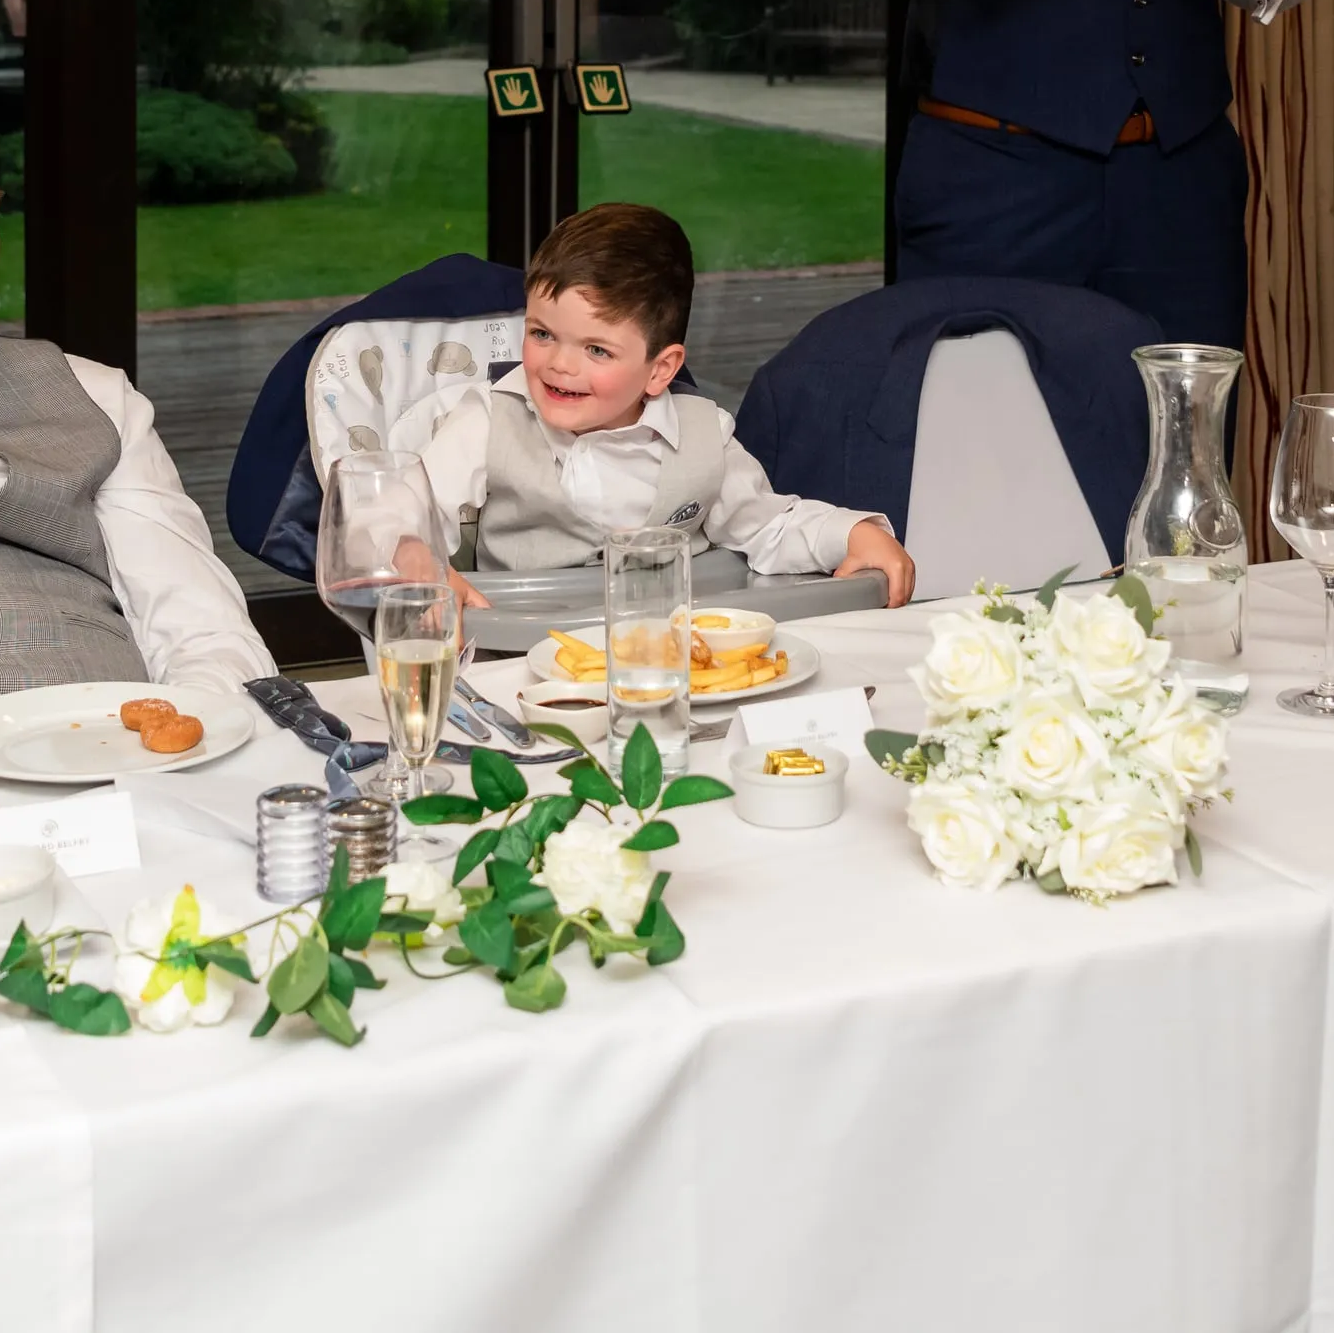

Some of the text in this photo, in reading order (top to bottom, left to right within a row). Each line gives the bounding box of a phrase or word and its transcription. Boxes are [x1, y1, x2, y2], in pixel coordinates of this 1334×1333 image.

[483, 321, 508, 333] bear
[491, 335, 506, 346] my
[490, 347, 512, 359] love
[336, 353, 350, 379] bear
